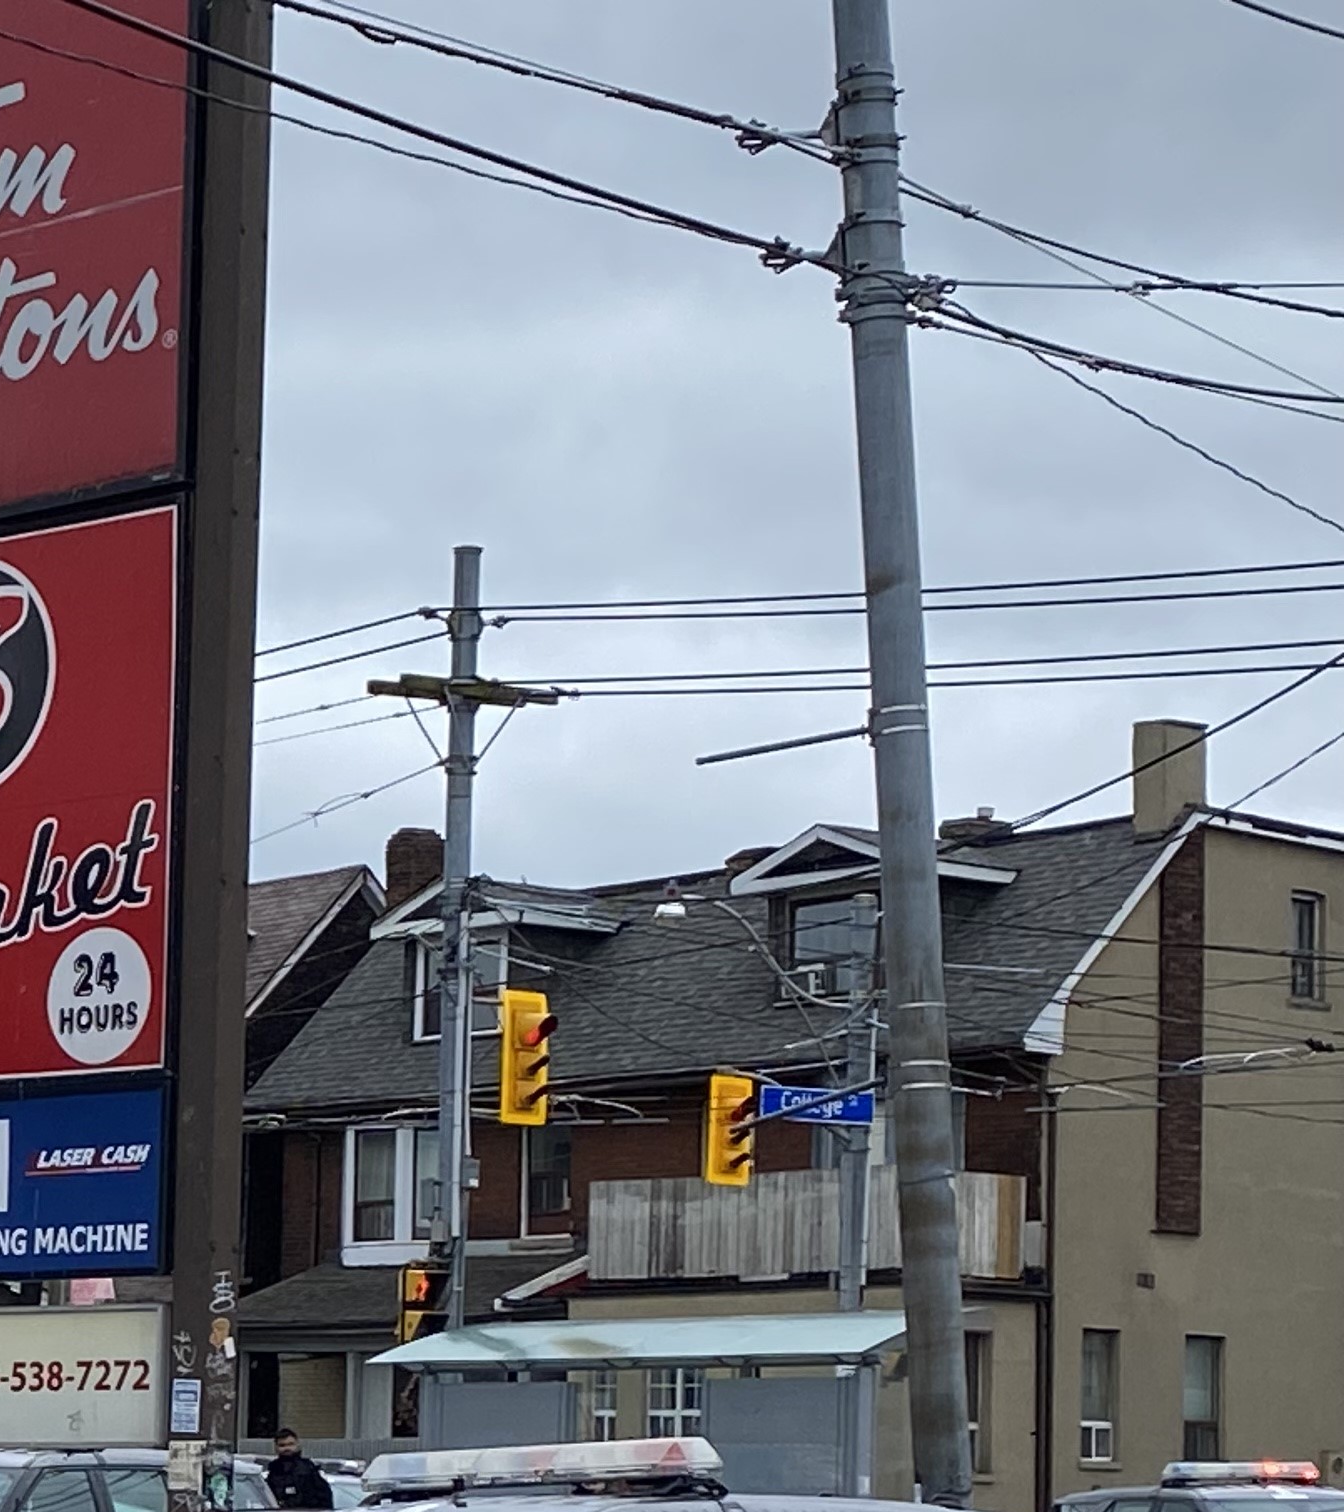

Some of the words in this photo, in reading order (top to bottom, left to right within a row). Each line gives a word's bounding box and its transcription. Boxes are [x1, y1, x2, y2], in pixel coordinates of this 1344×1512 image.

[72, 950, 120, 997] 24
[58, 999, 140, 1037] HOURS
[37, 1148, 95, 1169] LASER
[101, 1144, 151, 1165] CASH
[33, 1223, 149, 1255] MACHINE
